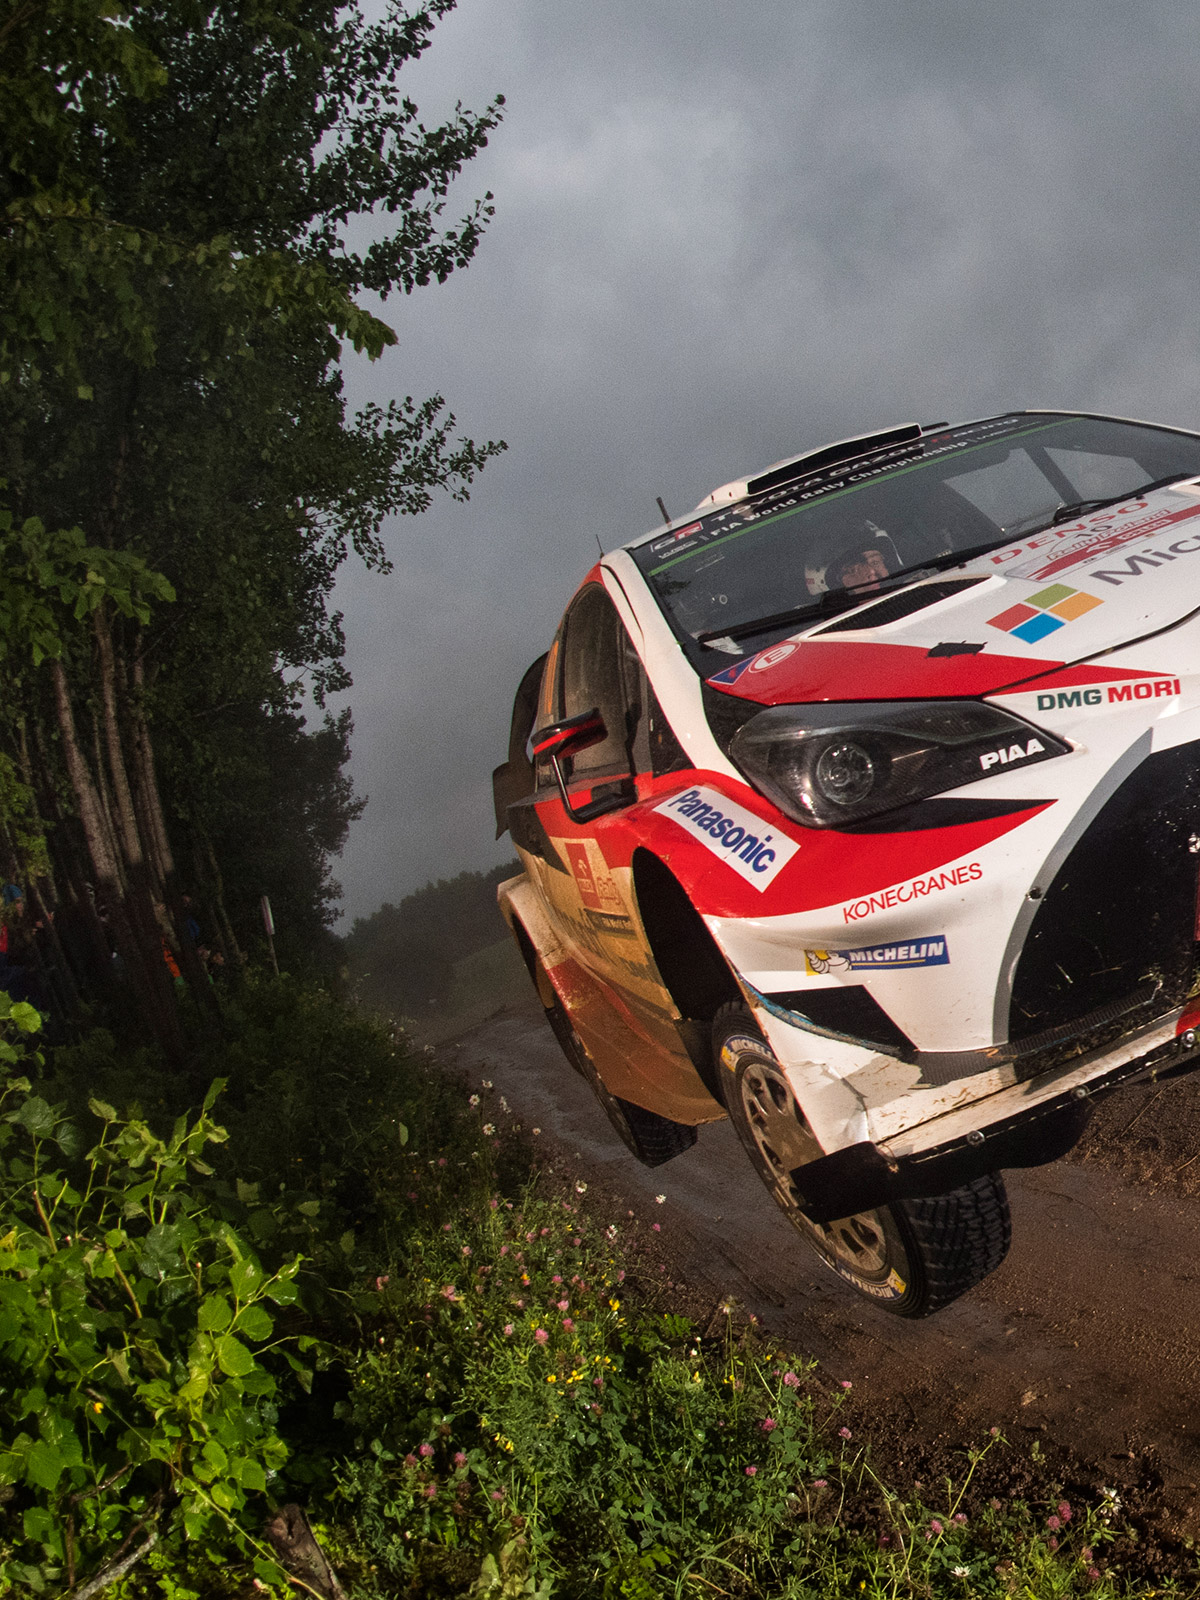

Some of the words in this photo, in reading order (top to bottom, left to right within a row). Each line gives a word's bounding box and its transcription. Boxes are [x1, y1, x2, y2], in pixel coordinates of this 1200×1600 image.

[710, 521, 743, 536] FIA
[743, 498, 797, 521] World
[800, 479, 845, 500] Rally
[848, 440, 968, 482] Championship
[989, 501, 1150, 565] DENSO
[1037, 689, 1102, 711] DMG
[1107, 679, 1181, 703] MORI
[979, 738, 1045, 770] PIAA
[667, 789, 776, 873] Panasonic
[843, 862, 983, 924] KONECRANES
[850, 941, 945, 962] MICHELIN
